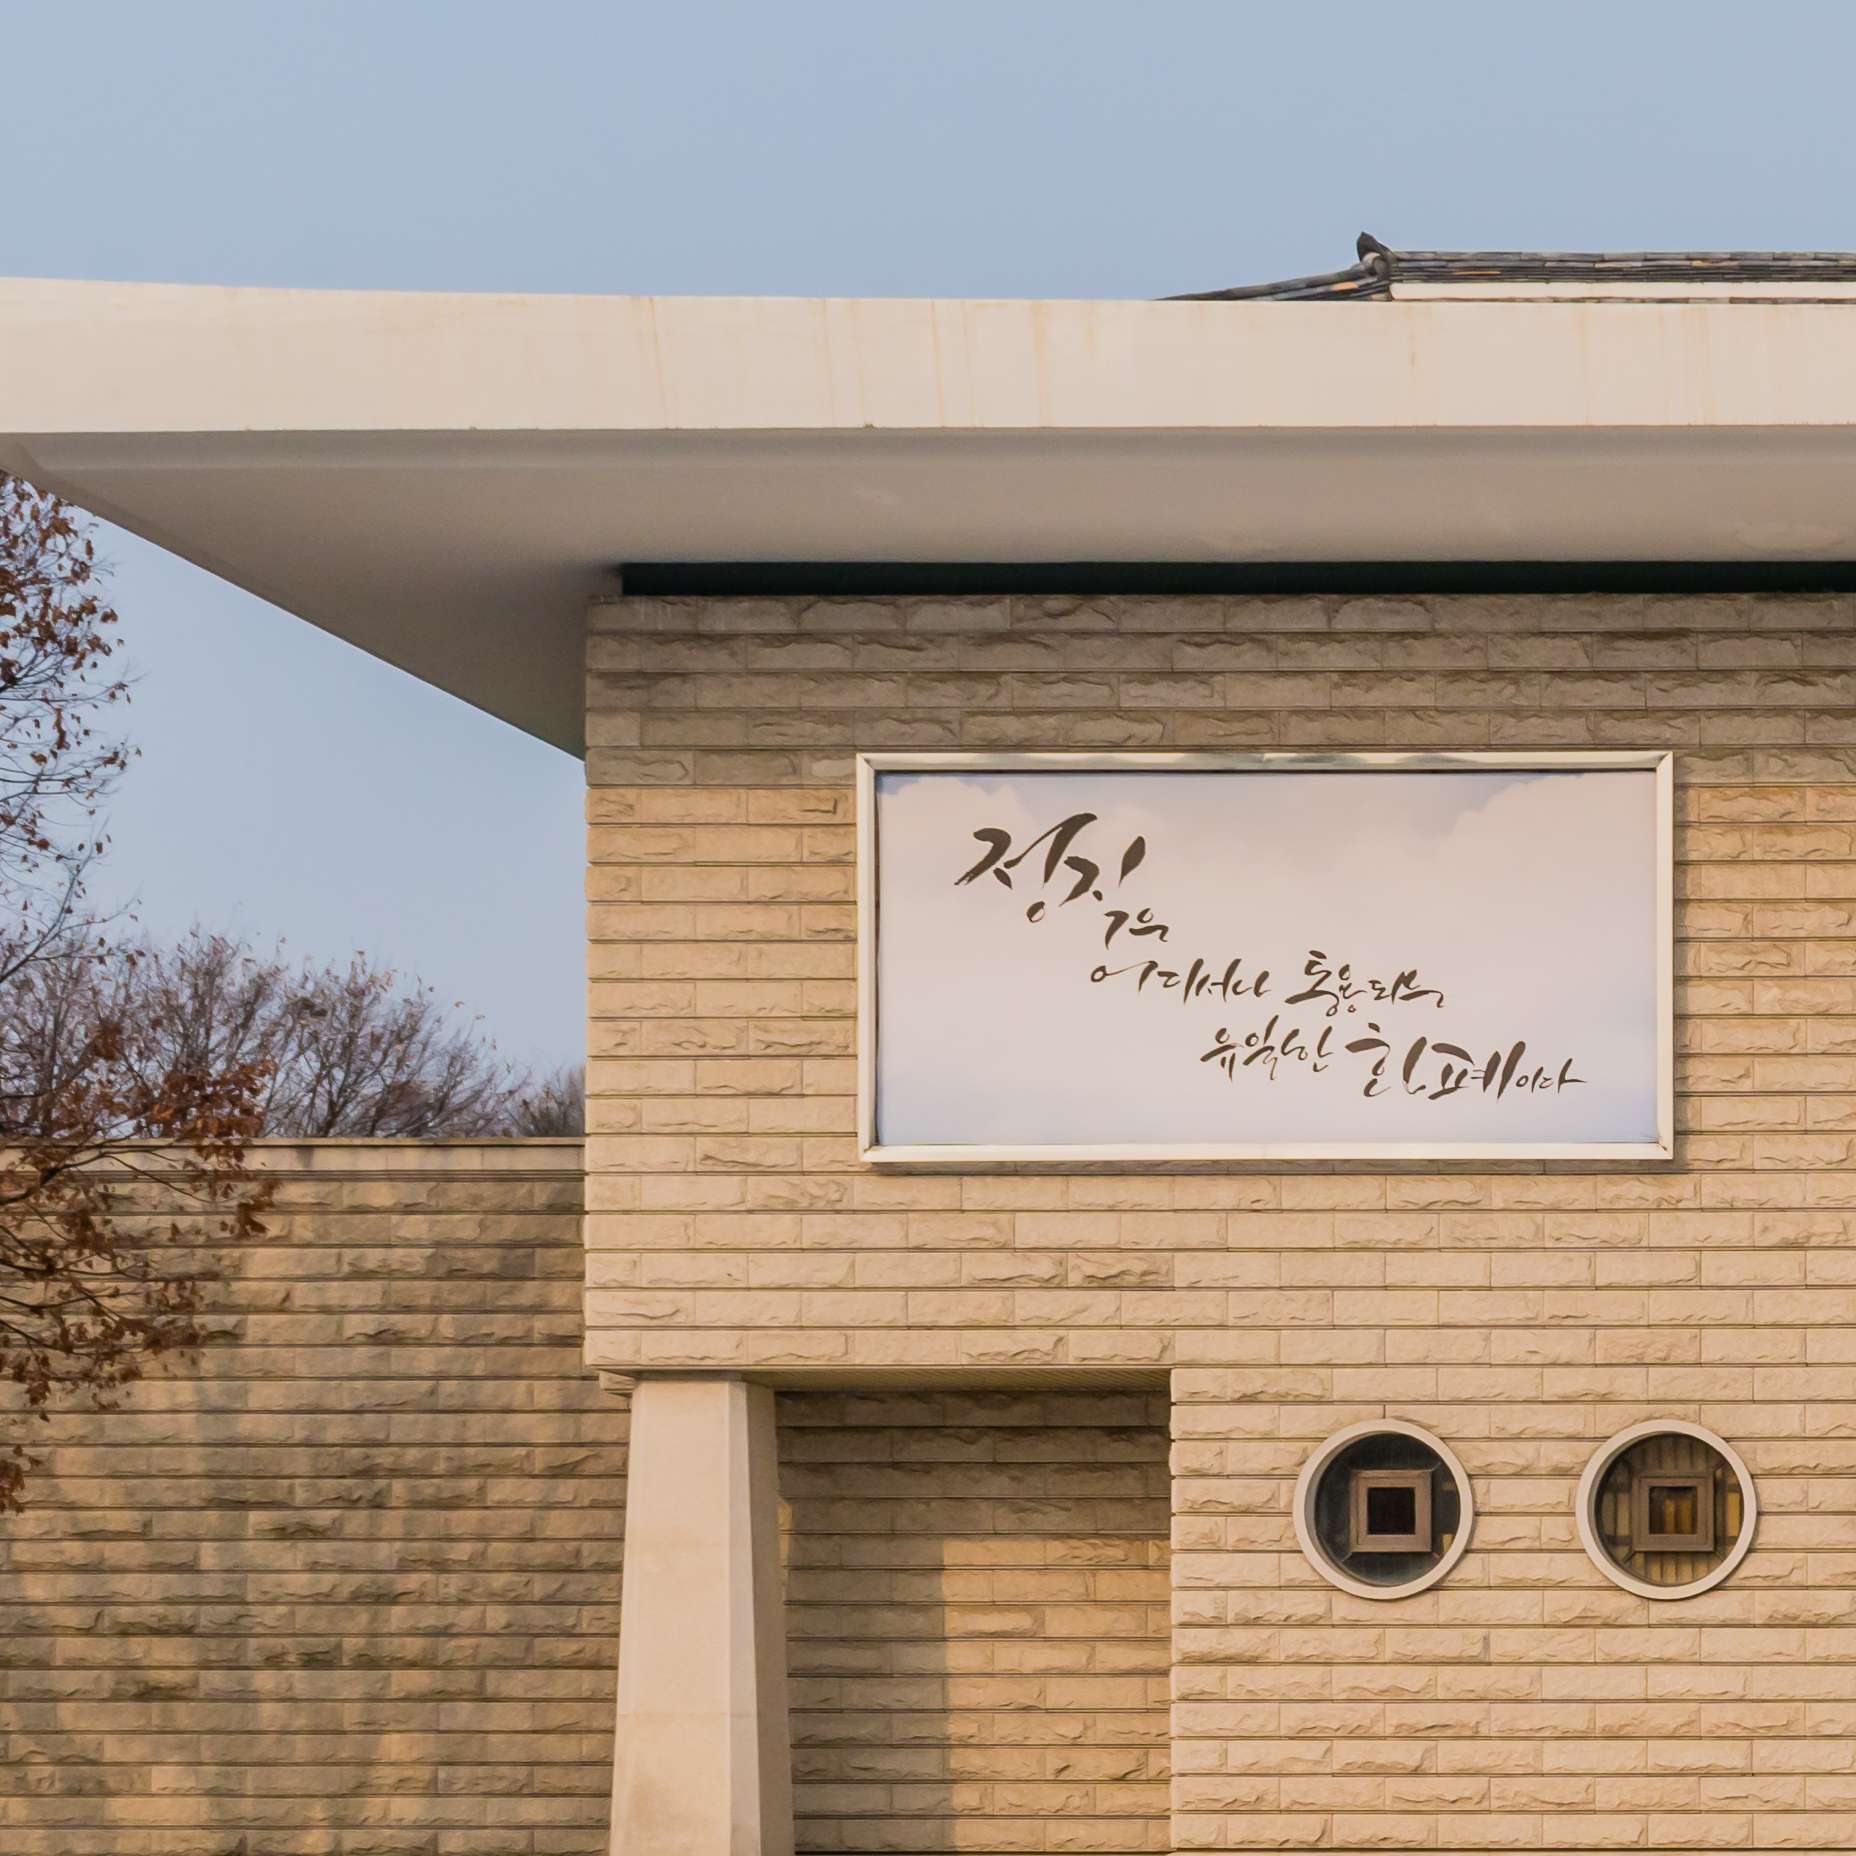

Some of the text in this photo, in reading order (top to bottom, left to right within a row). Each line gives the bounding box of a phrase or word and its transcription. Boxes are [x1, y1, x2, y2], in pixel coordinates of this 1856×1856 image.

[1090, 949, 1446, 1017] 어디서나 통용되는
[1199, 1014, 1588, 1104] 유일한 화폐이다
